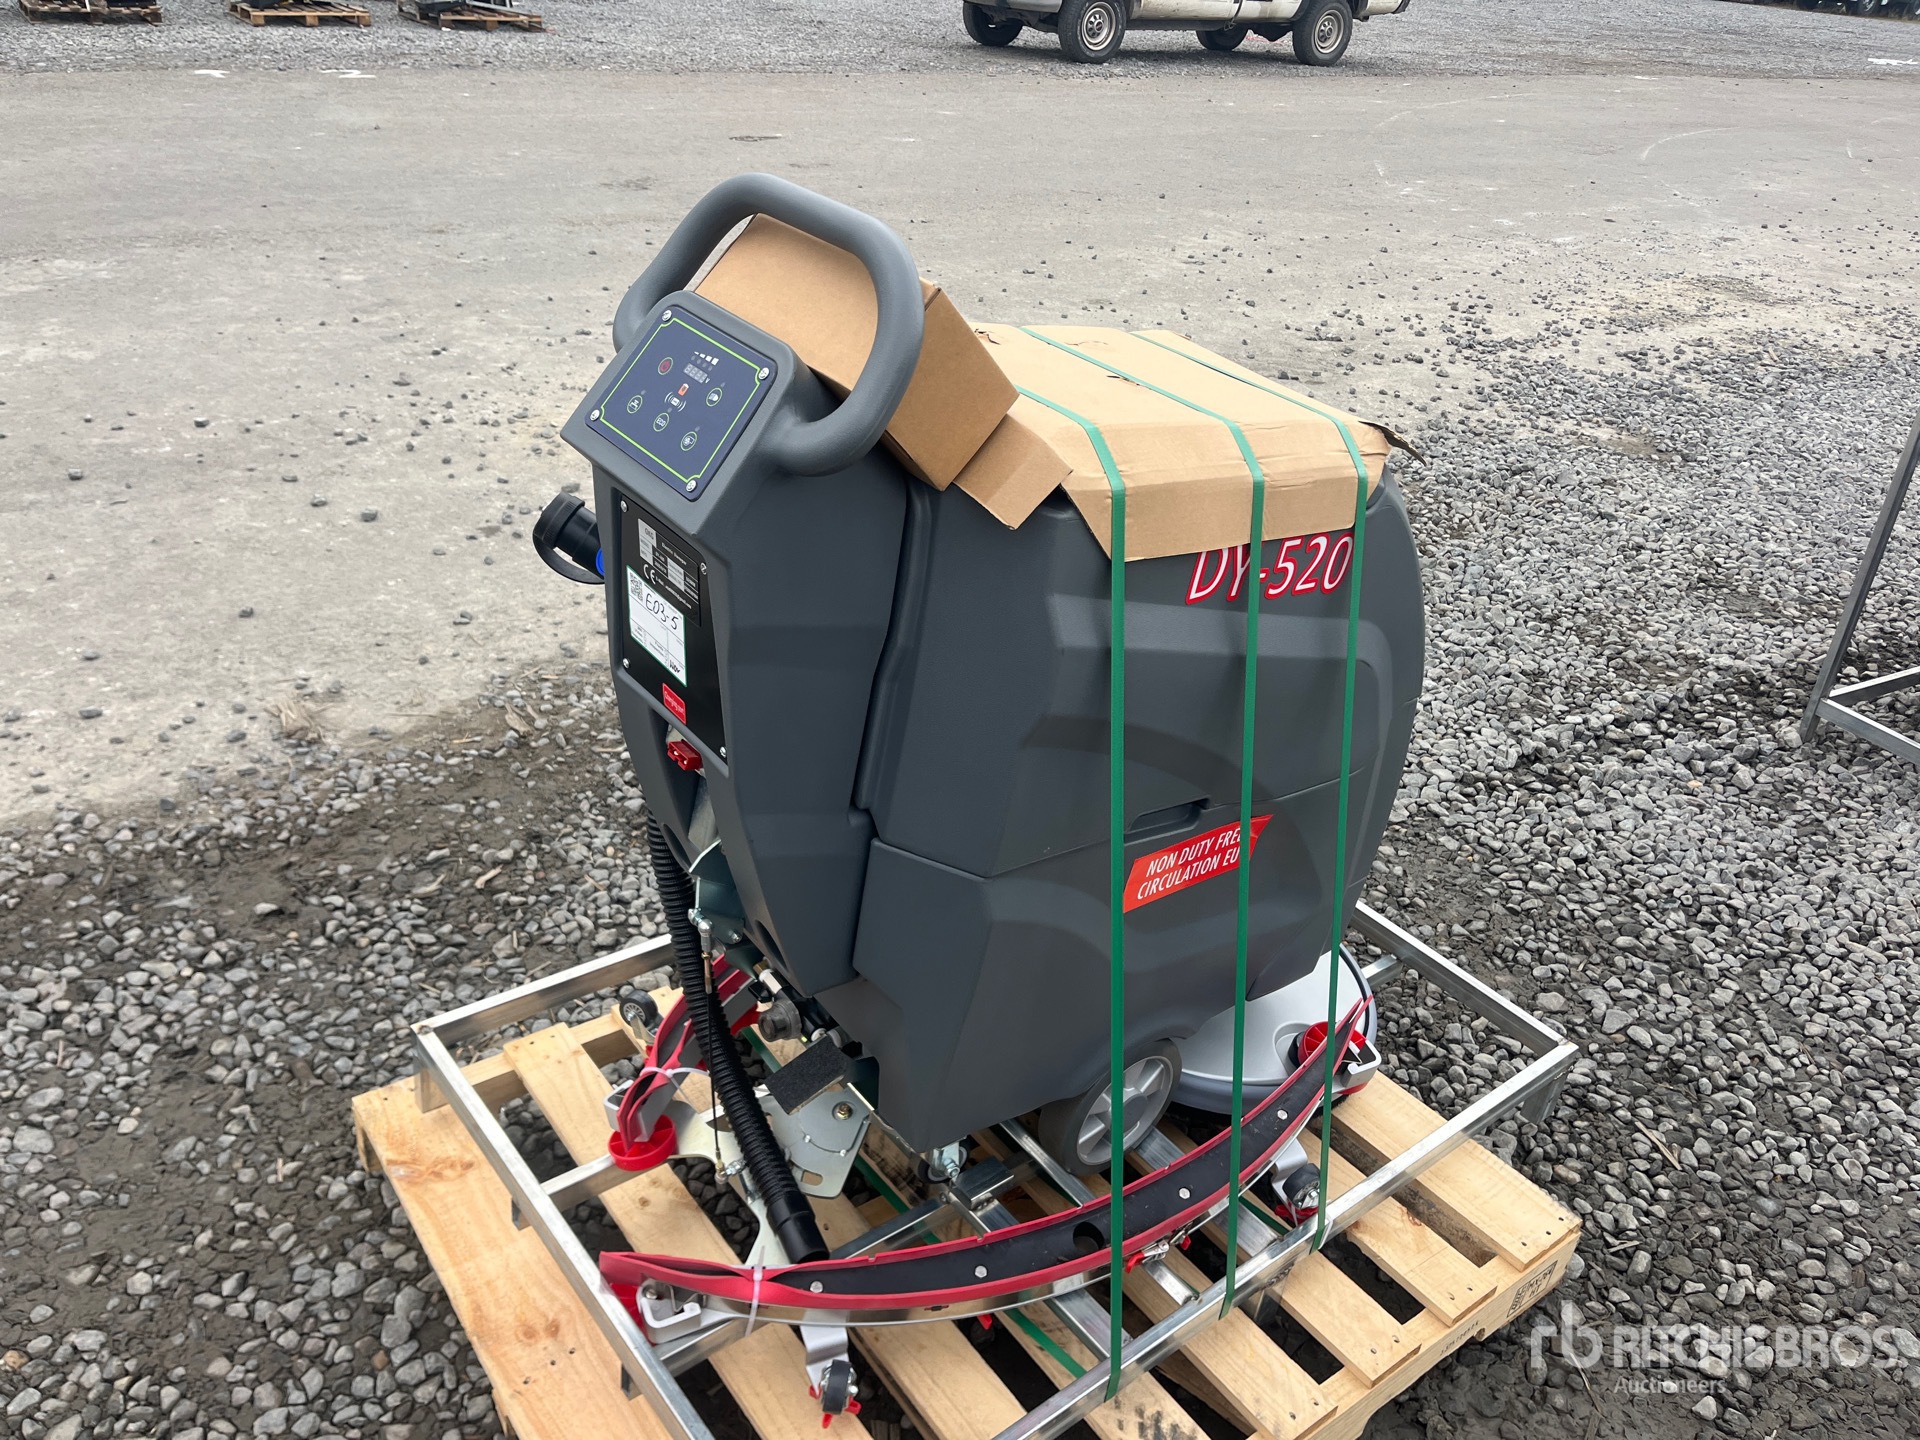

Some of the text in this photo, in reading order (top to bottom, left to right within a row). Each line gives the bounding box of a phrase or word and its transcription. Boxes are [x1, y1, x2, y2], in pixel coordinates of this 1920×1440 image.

[1137, 848, 1241, 900] CIRCULATION EU
[1146, 851, 1179, 877] NON
[1178, 836, 1216, 866] DUTY
